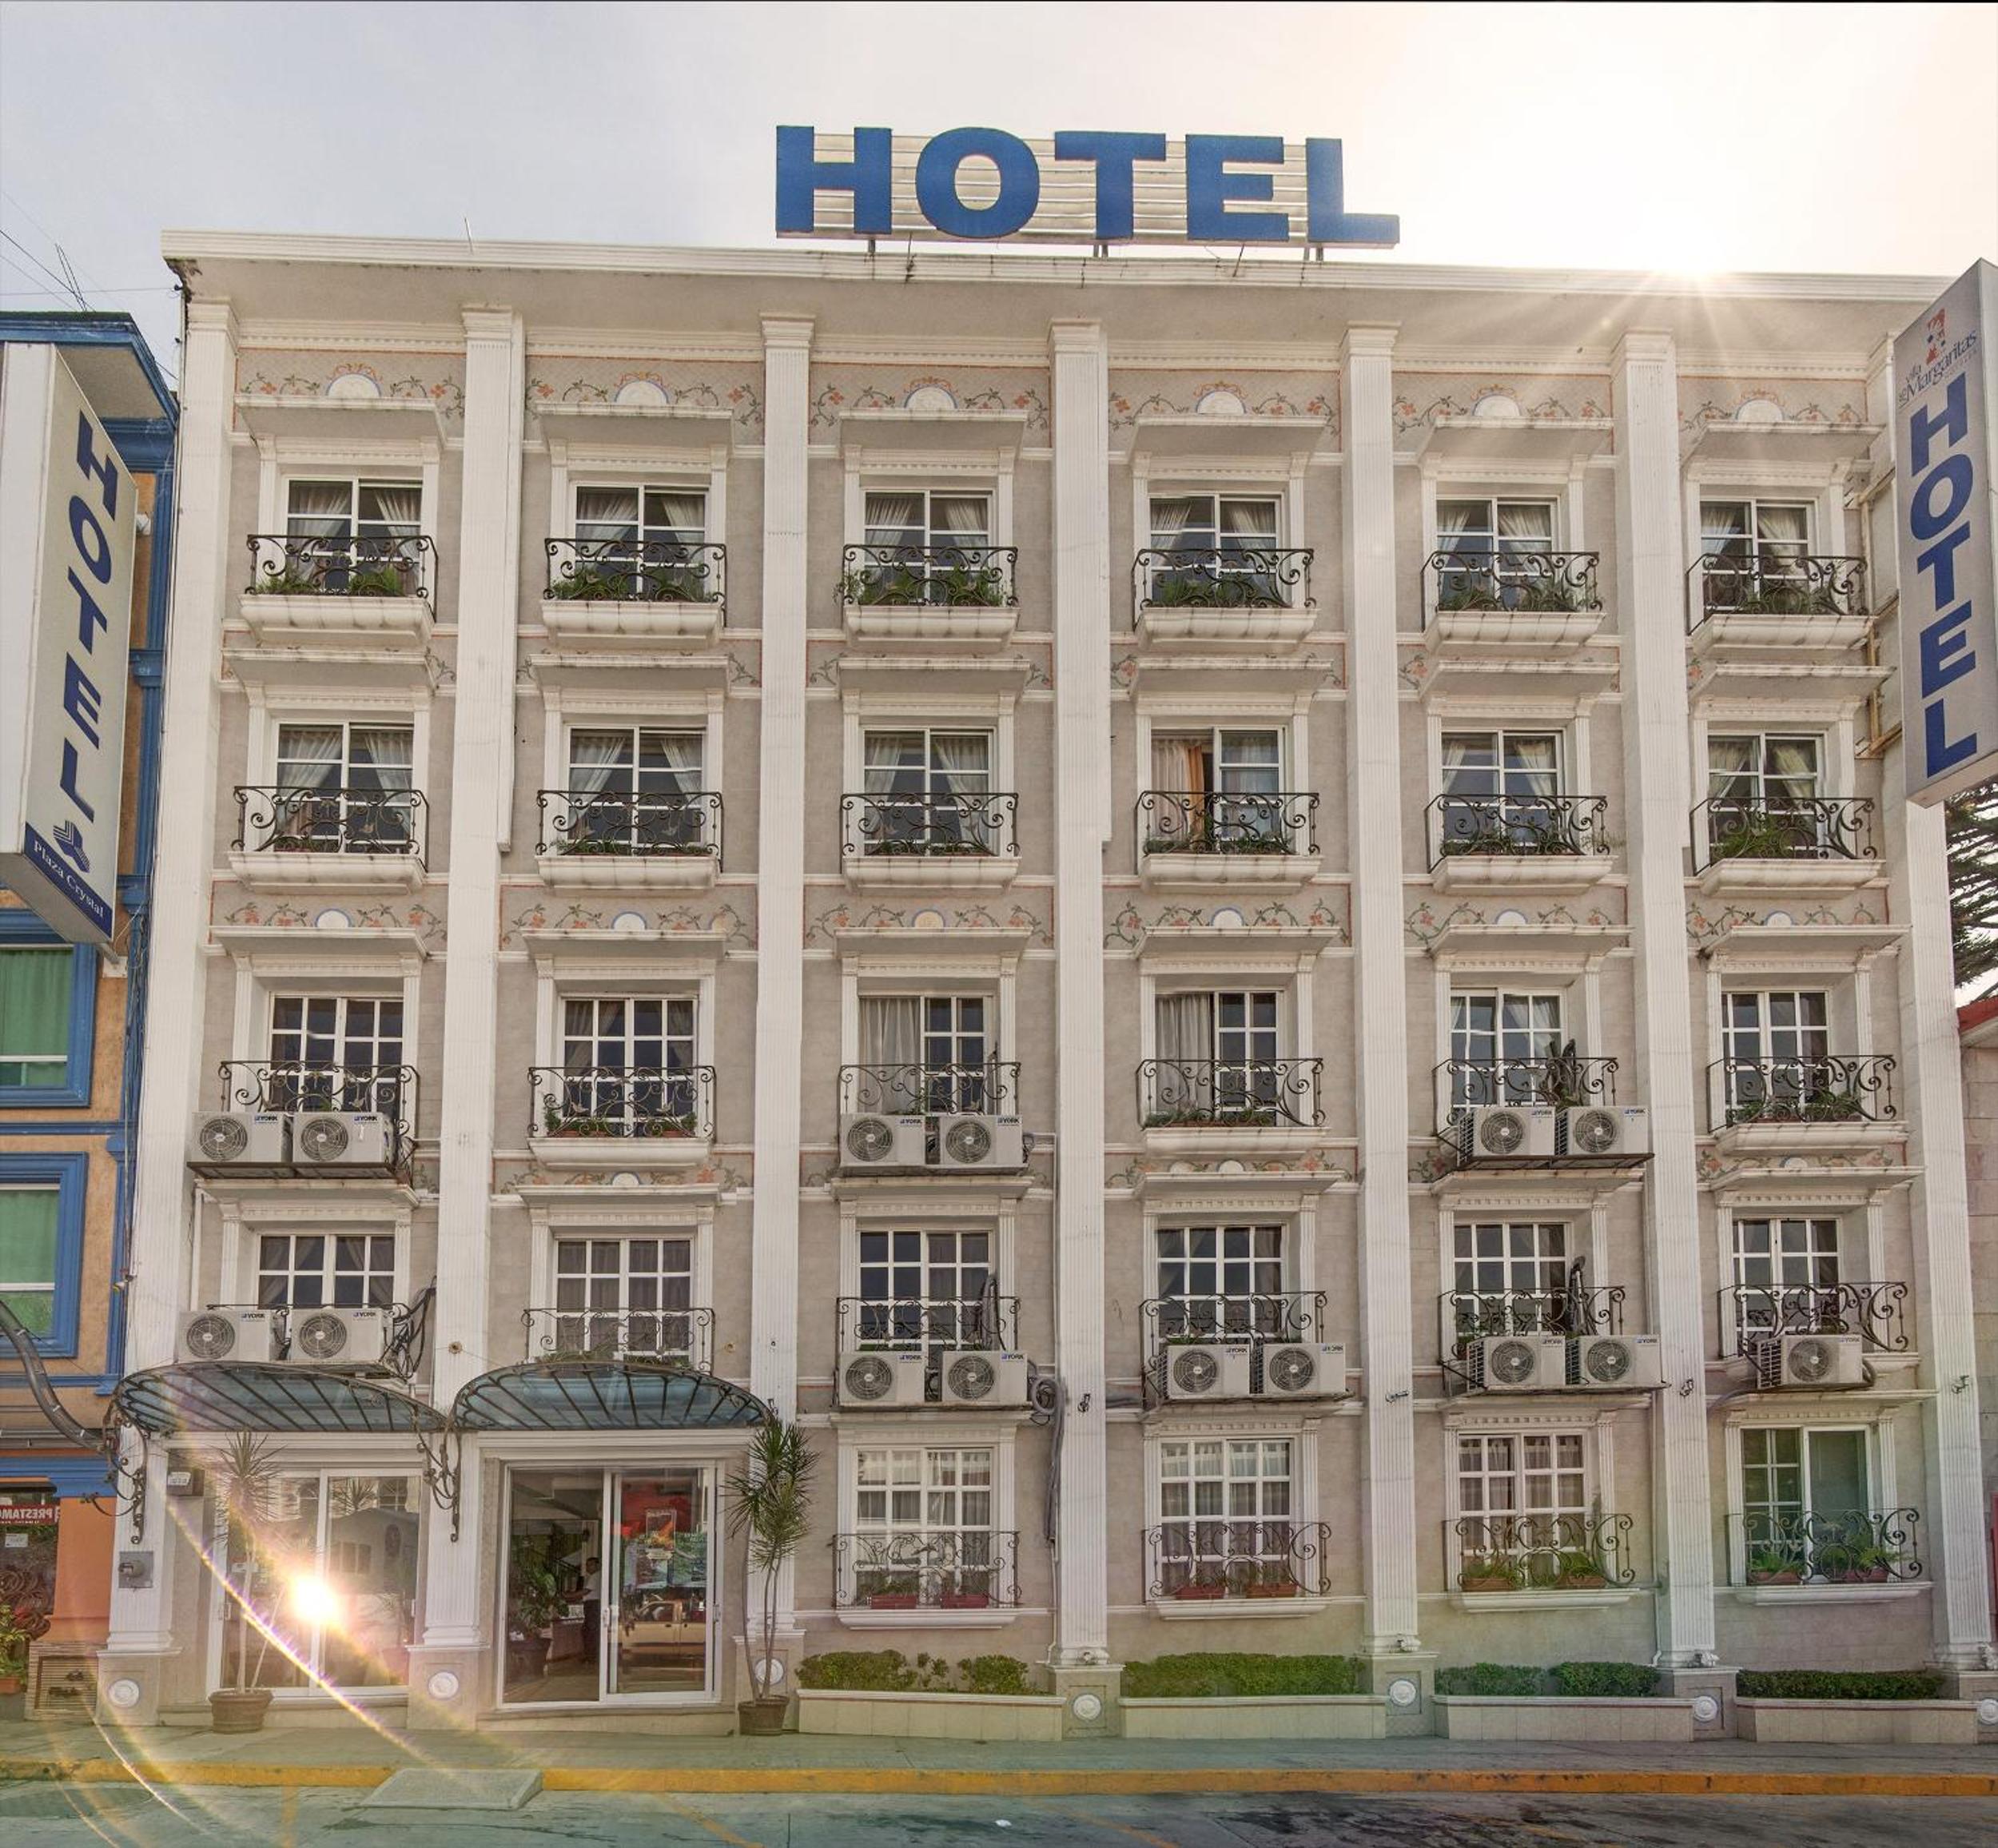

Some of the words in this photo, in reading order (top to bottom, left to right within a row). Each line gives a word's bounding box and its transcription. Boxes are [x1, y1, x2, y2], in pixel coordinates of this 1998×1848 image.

[776, 125, 1399, 244] HOTEL
[1905, 329, 1976, 401] Margaritas
[60, 409, 118, 824] HOTEL
[1909, 371, 1977, 779] HOTEL
[34, 839, 64, 878] Plaza
[66, 874, 104, 918] Crystal
